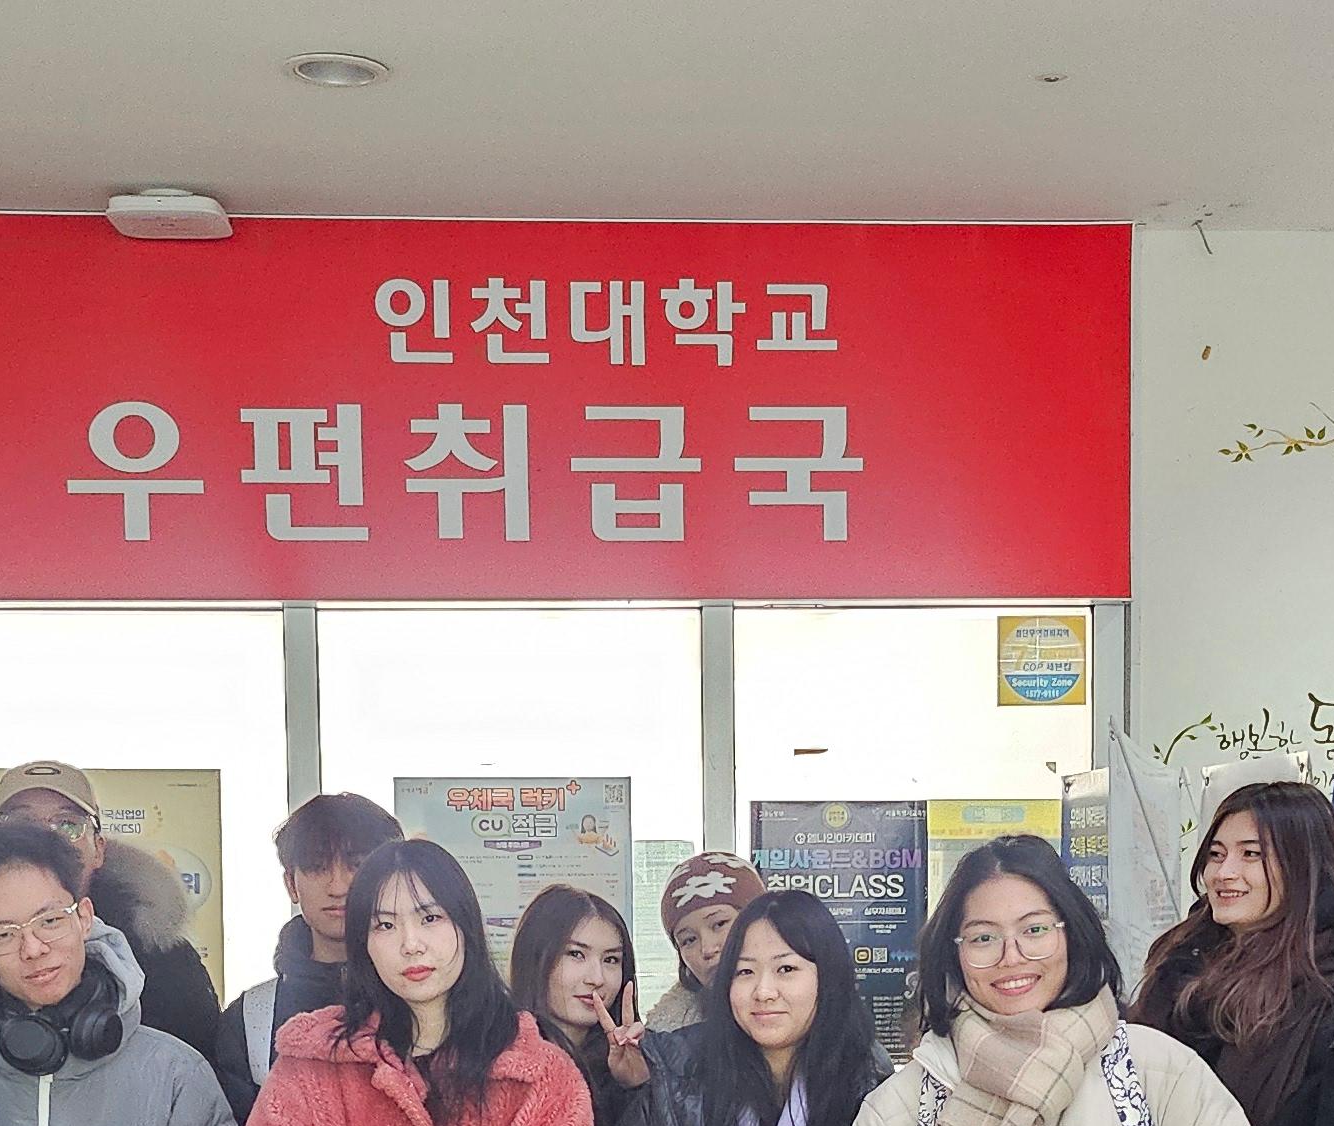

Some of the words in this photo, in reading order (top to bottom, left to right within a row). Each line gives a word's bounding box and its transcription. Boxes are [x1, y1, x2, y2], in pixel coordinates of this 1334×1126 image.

[373, 277, 839, 367] 인천대학교
[67, 400, 864, 542] 우편취급국
[1011, 677, 1049, 688] Security
[1051, 677, 1073, 688] Zone
[446, 788, 516, 812] 우체국
[101, 808, 146, 820] 국산업의
[478, 819, 504, 832] CU
[512, 814, 558, 837] 적금
